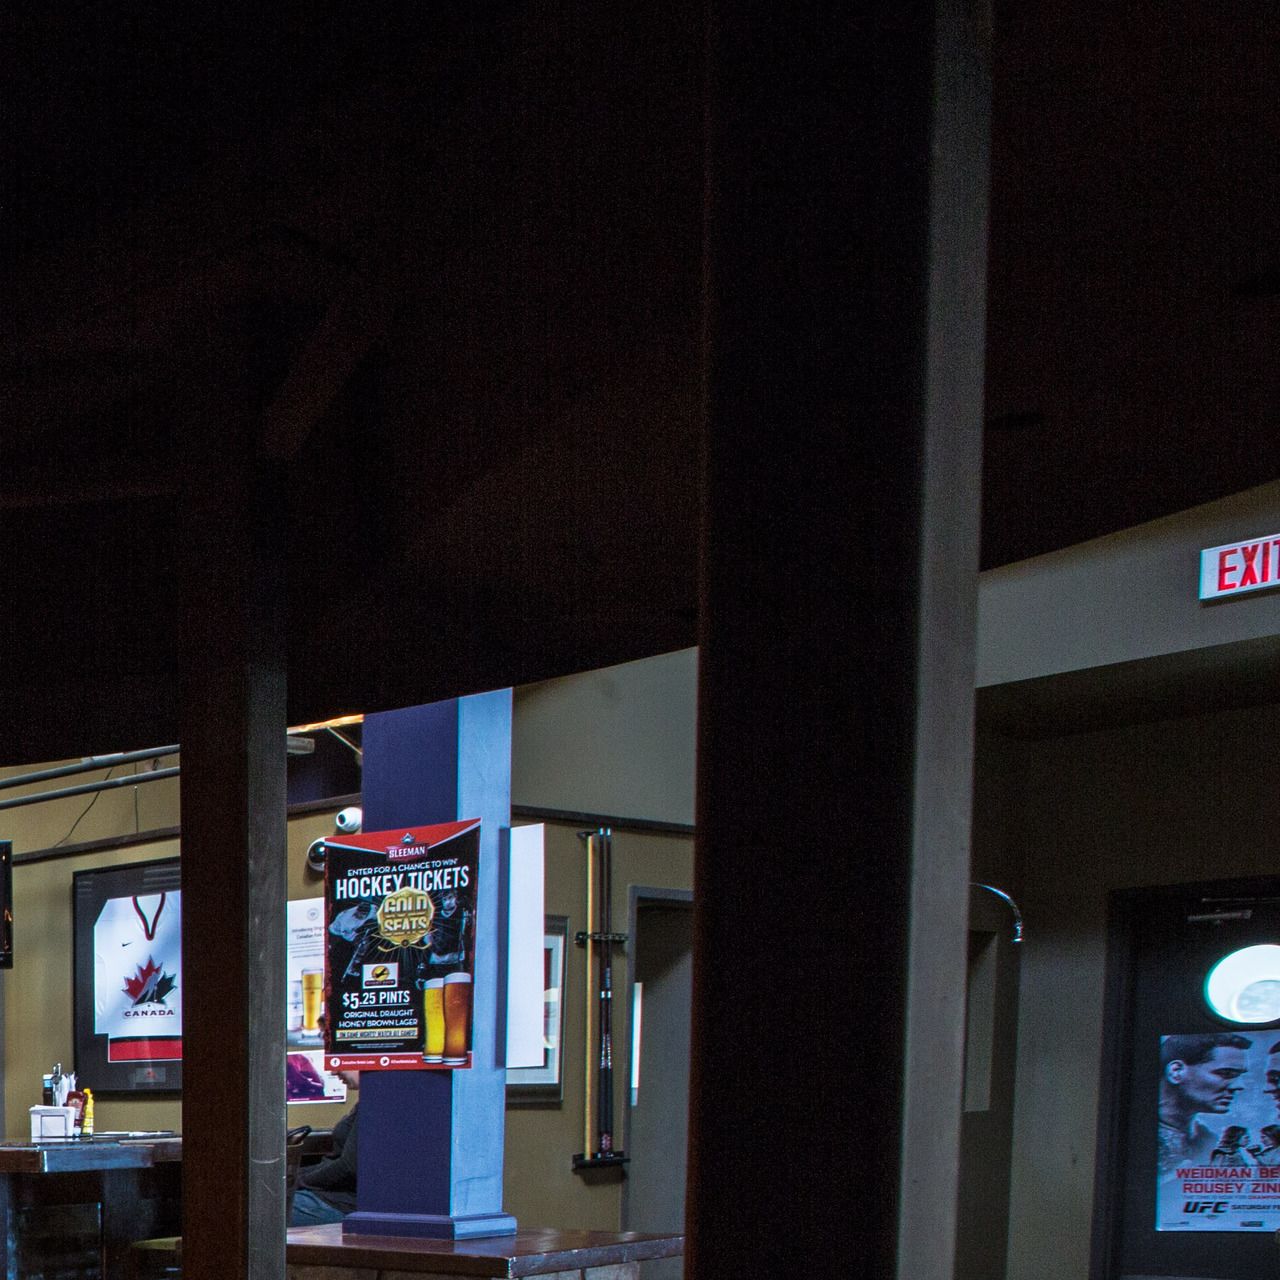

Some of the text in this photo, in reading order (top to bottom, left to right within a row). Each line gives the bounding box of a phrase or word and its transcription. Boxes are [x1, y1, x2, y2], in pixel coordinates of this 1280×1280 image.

[388, 846, 425, 858] SLEEMAN
[347, 868, 373, 876] ENTER
[397, 861, 430, 872] CHANCE
[431, 860, 441, 868] TO
[336, 865, 469, 899] HOCKEY TICKETS
[384, 894, 427, 918] GOLD
[384, 916, 427, 936] SEATS
[342, 990, 410, 1009] $5.25 PINTS
[124, 1009, 174, 1017] CANADA
[343, 1009, 414, 1019] ORIGINAL DRAUGHT
[338, 1021, 366, 1029] HONEY
[1176, 1168, 1252, 1179] WEIDMAN
[1183, 1183, 1244, 1193] ROUSEY
[1183, 1201, 1229, 1214] UFC
